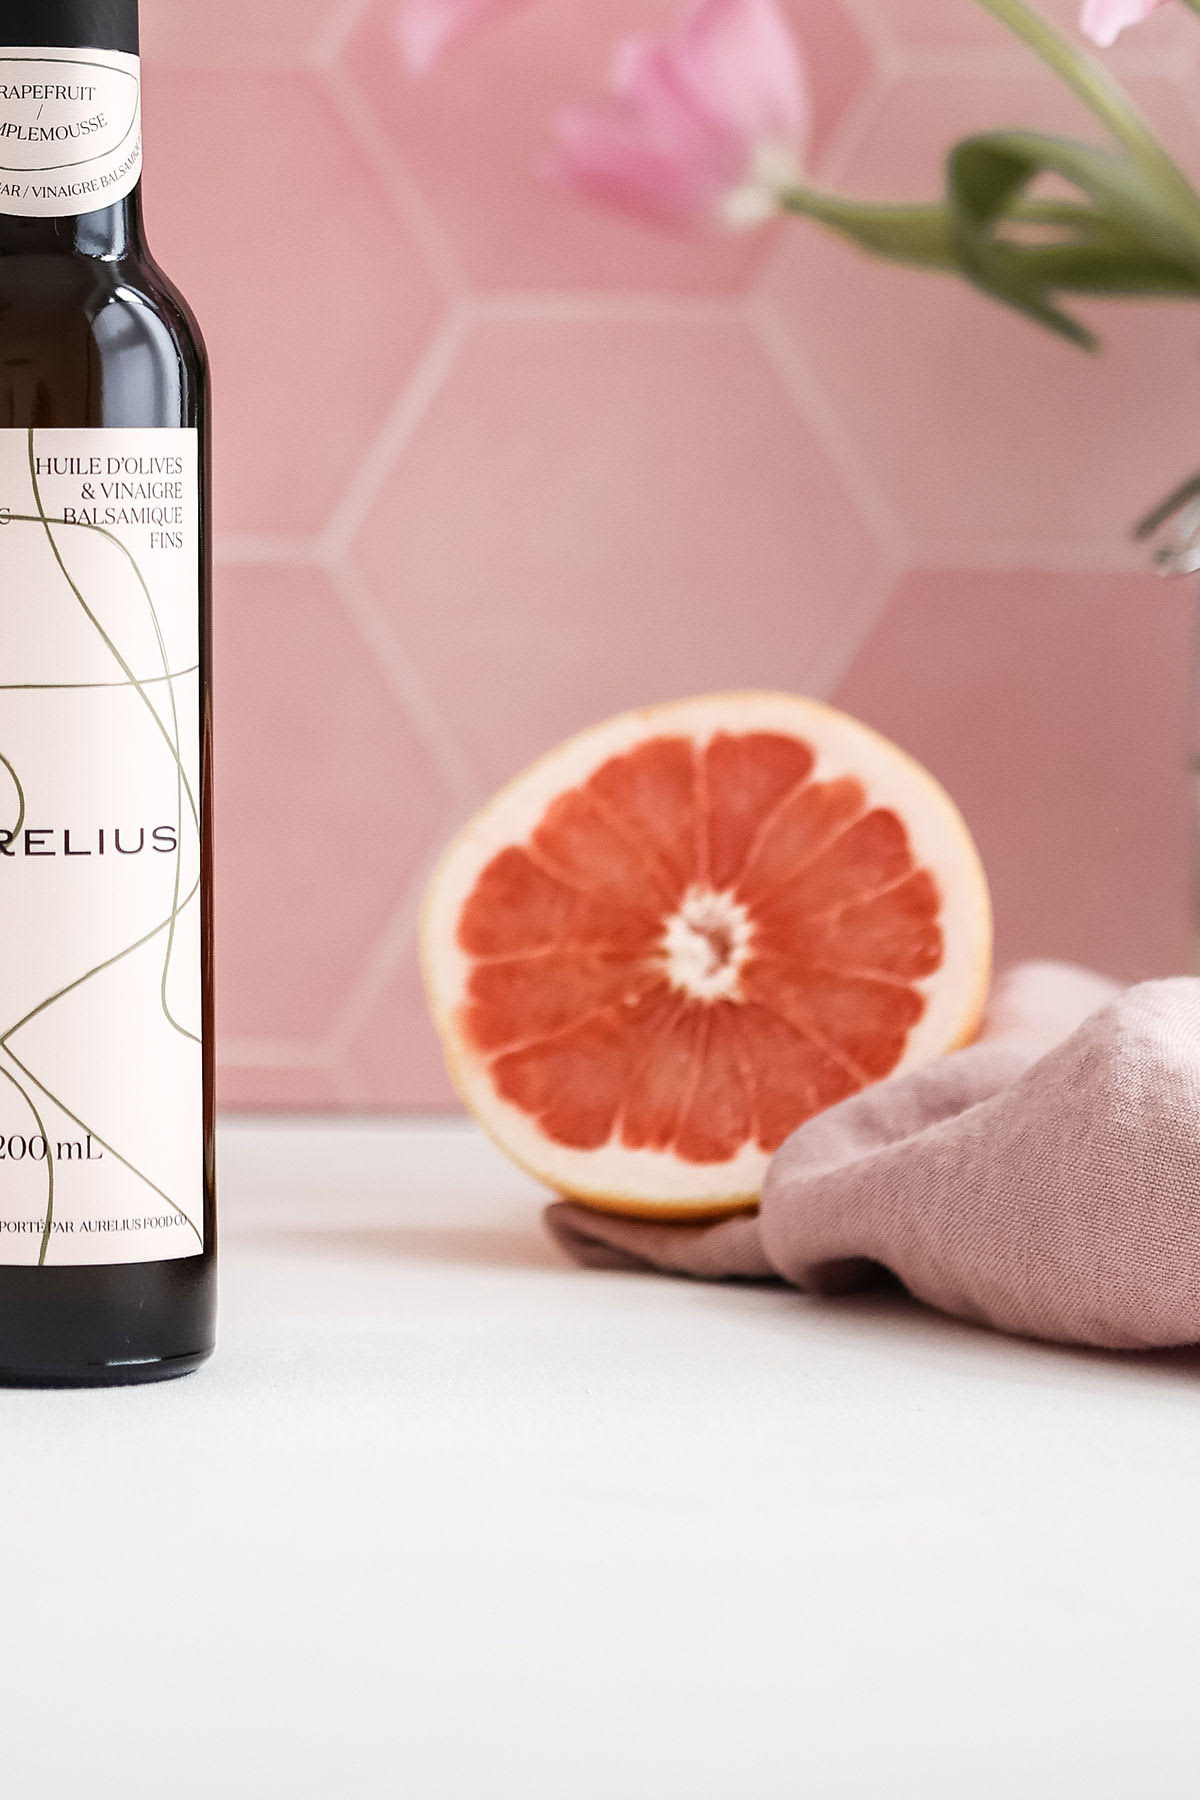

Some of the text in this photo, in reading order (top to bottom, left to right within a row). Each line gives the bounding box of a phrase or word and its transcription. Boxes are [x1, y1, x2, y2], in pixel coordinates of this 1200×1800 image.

[31, 178, 100, 199] VINAIGRE
[35, 456, 183, 475] HUILE D’OLIVES
[80, 481, 183, 500] & VINAIGRE
[63, 506, 183, 526] BALSAMIQUE
[149, 531, 183, 550] FINS
[56, 1133, 103, 1161] mL
[47, 1220, 75, 1234] PAR
[79, 1218, 142, 1234] AURELIUS
[143, 1214, 173, 1230] FOOD
